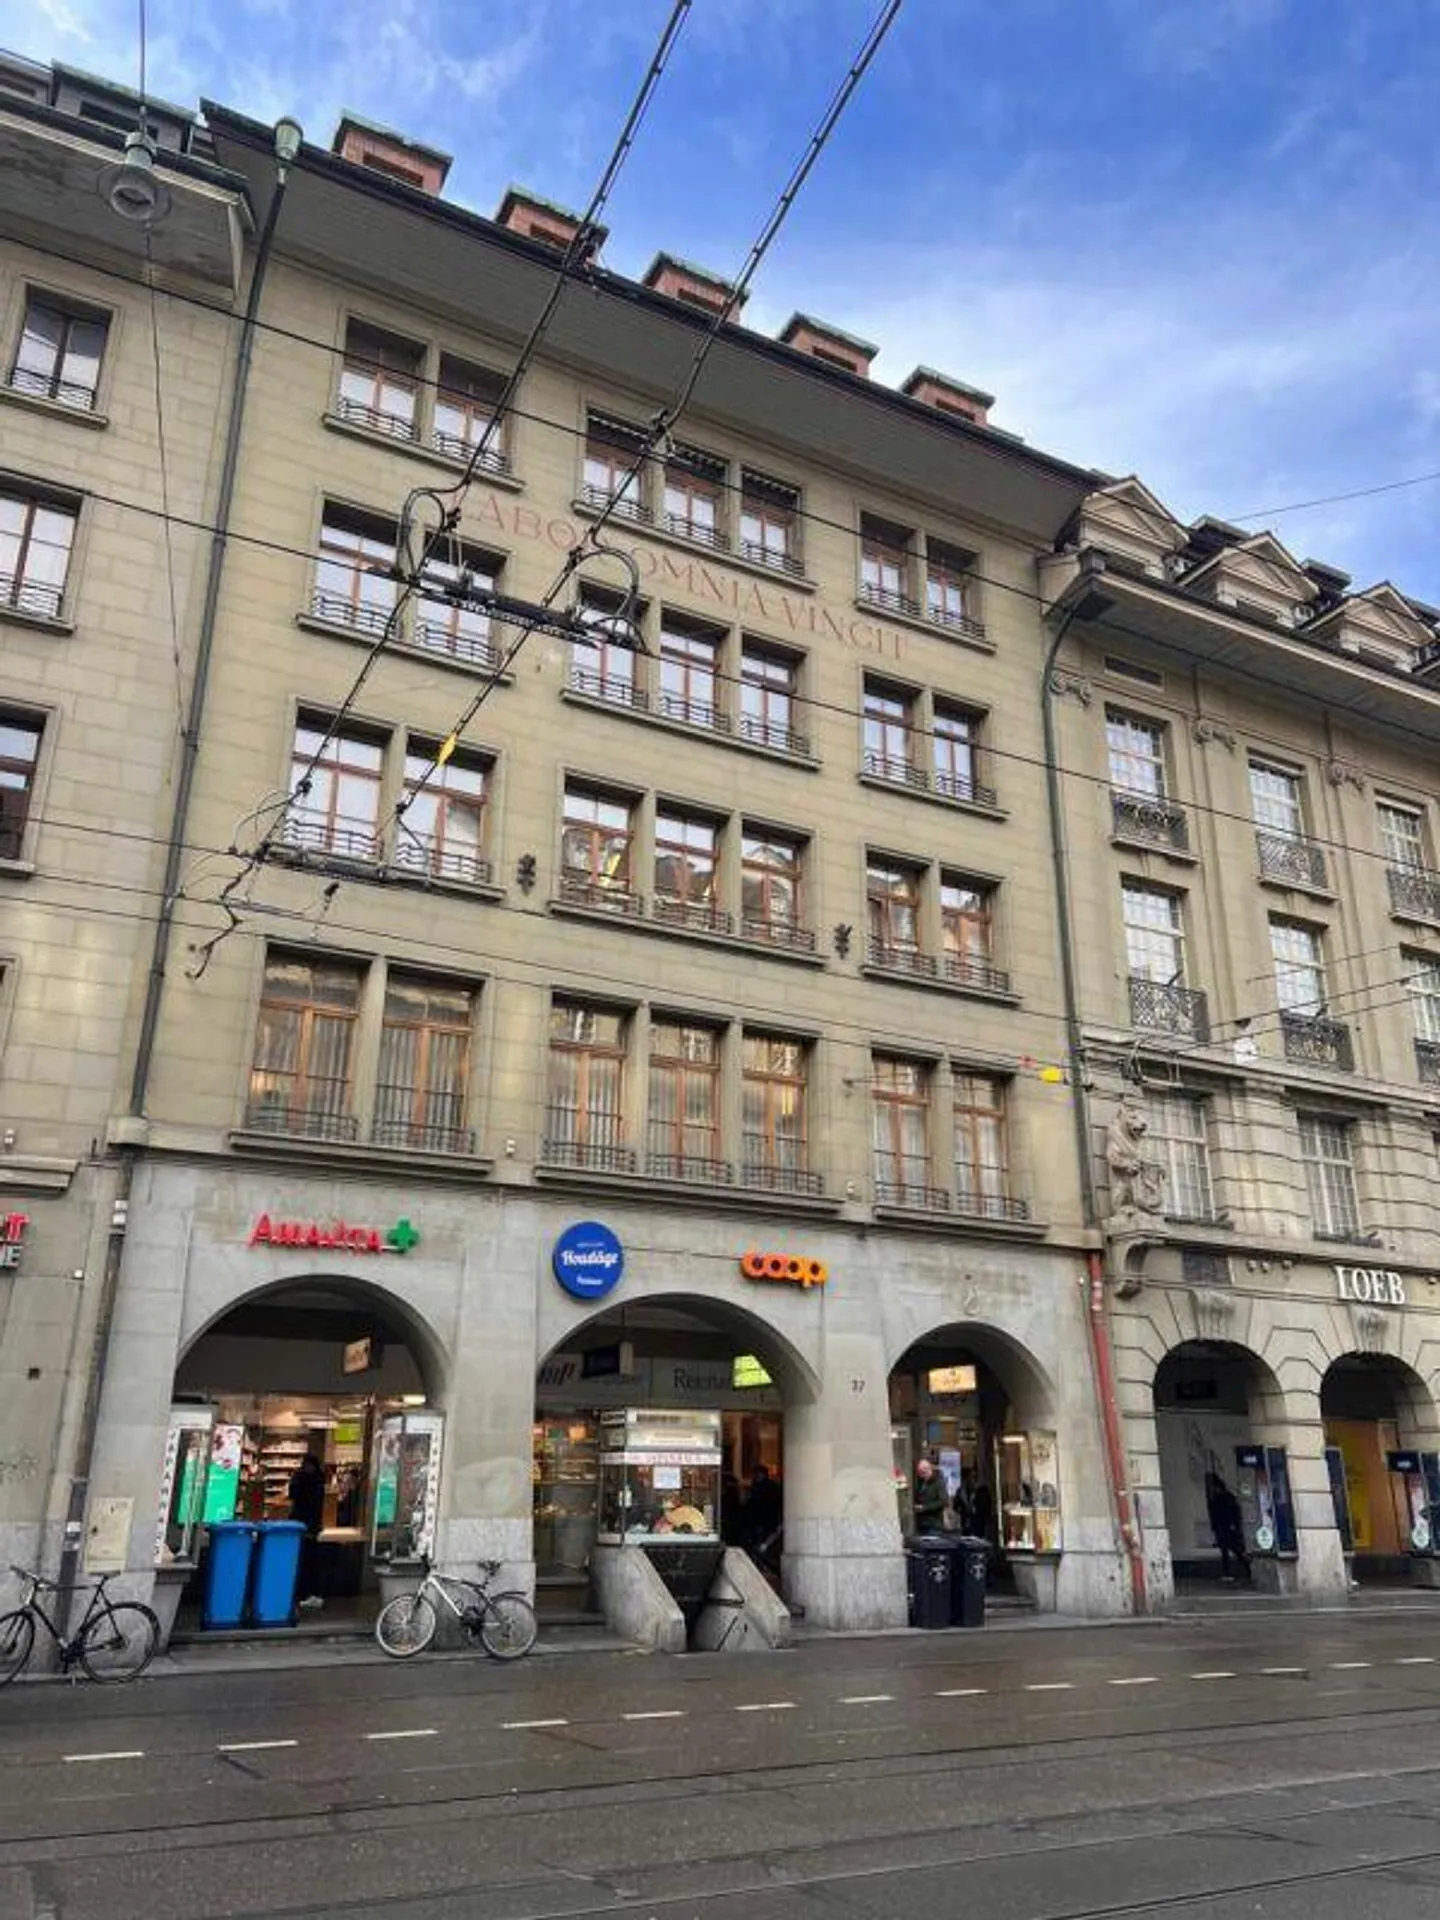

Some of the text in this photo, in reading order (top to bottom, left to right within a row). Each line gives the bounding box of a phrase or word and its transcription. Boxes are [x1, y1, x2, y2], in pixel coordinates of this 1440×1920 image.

[450, 487, 909, 660] ABO OMNIA VINCIT
[741, 1250, 827, 1289] coop
[1333, 1265, 1406, 1304] LOEB
